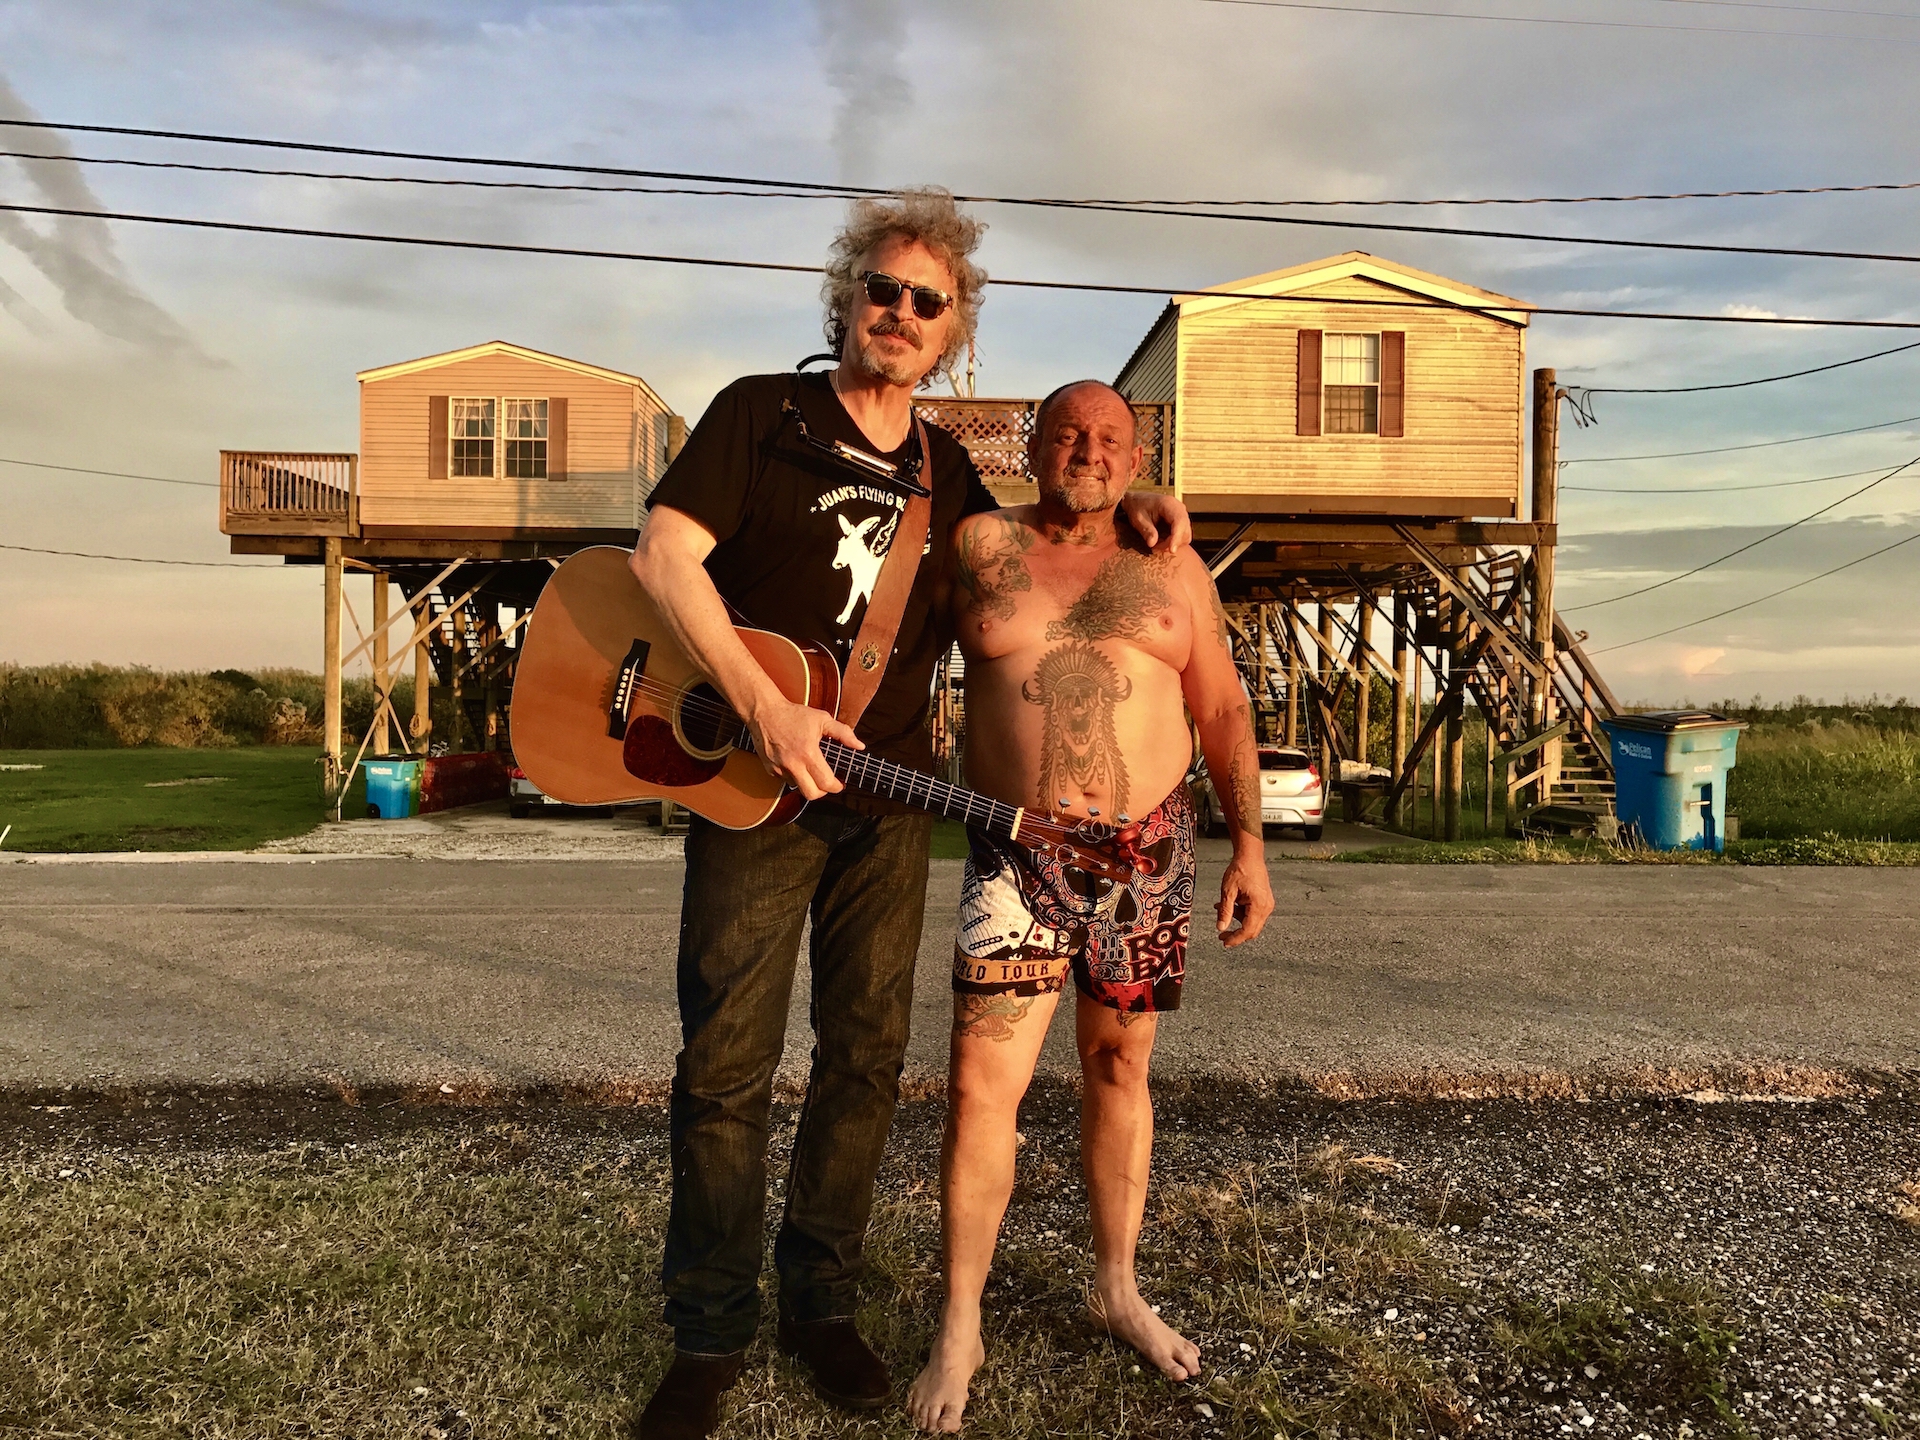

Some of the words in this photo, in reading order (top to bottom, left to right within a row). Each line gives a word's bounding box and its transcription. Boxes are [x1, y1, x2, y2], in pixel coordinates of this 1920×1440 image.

[818, 486, 858, 512] JUAN'S
[859, 486, 895, 506] FLYING
[1629, 742, 1652, 756] Pelican
[1001, 962, 1049, 980] TOUR
